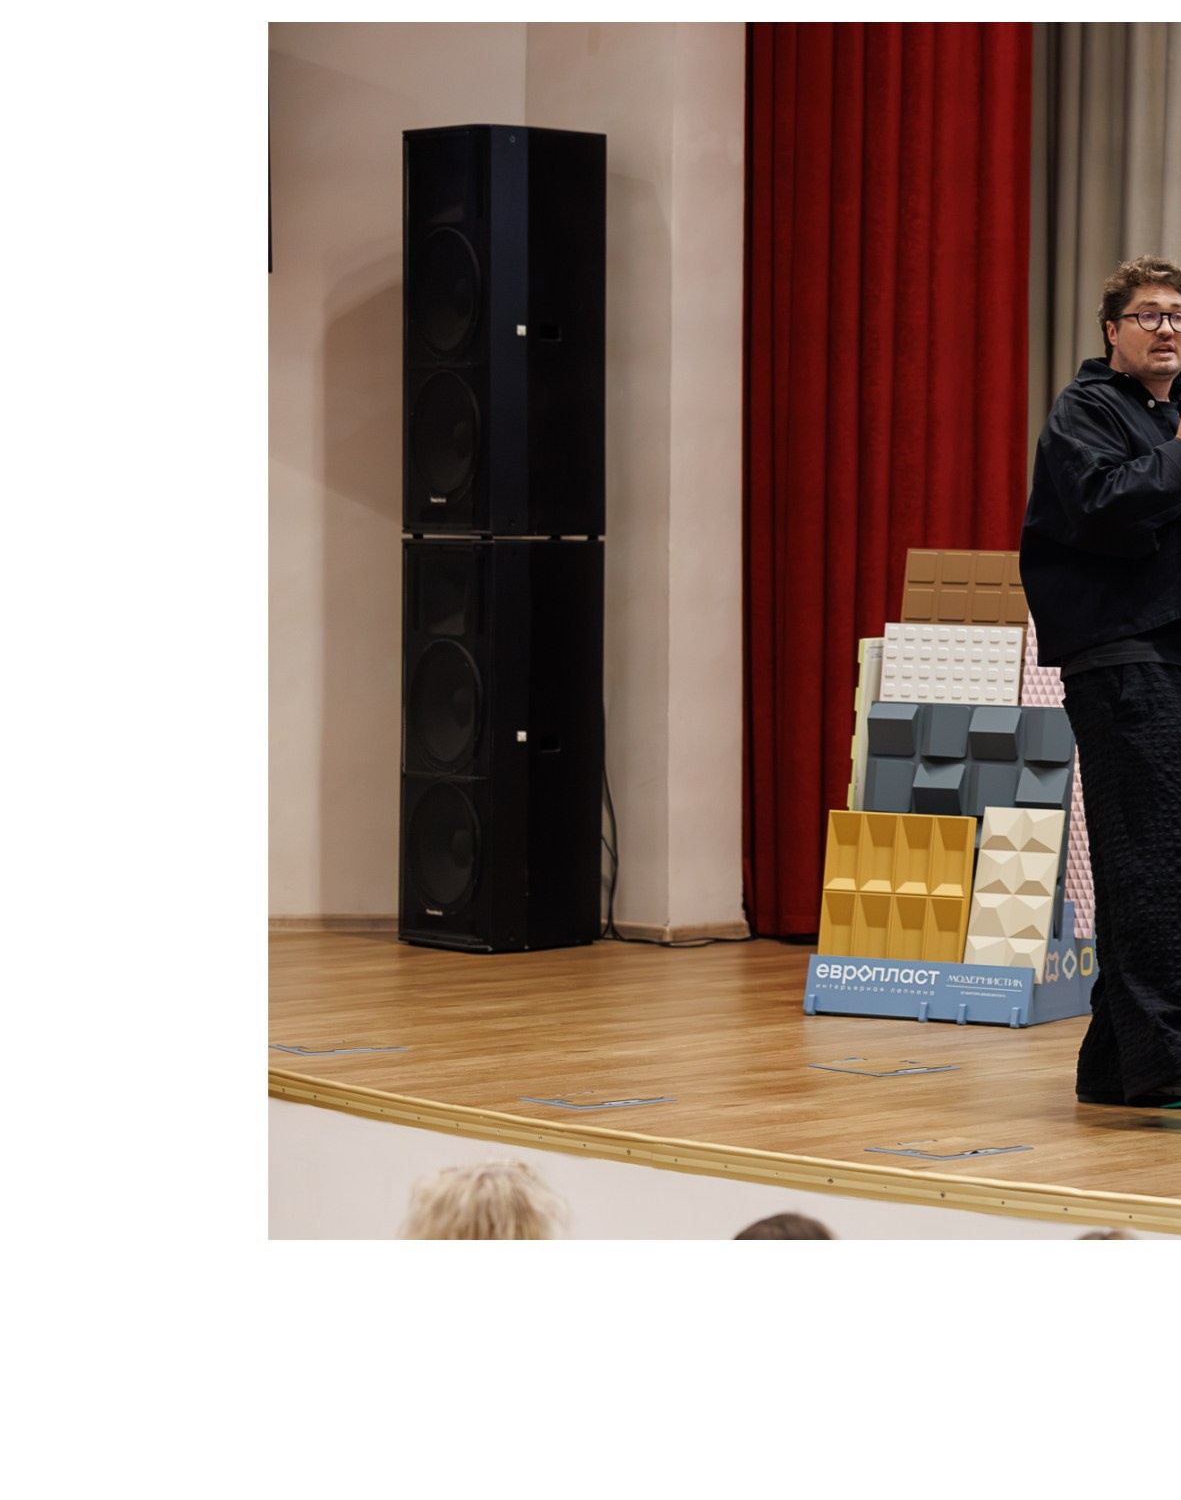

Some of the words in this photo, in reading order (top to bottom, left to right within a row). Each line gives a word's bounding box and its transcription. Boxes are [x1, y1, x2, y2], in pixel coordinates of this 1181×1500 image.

[815, 963, 941, 986] европласт
[946, 973, 1024, 988] МОДЕРНИСТИК
[815, 983, 885, 993] интерьерная
[890, 987, 935, 997] лепнина
